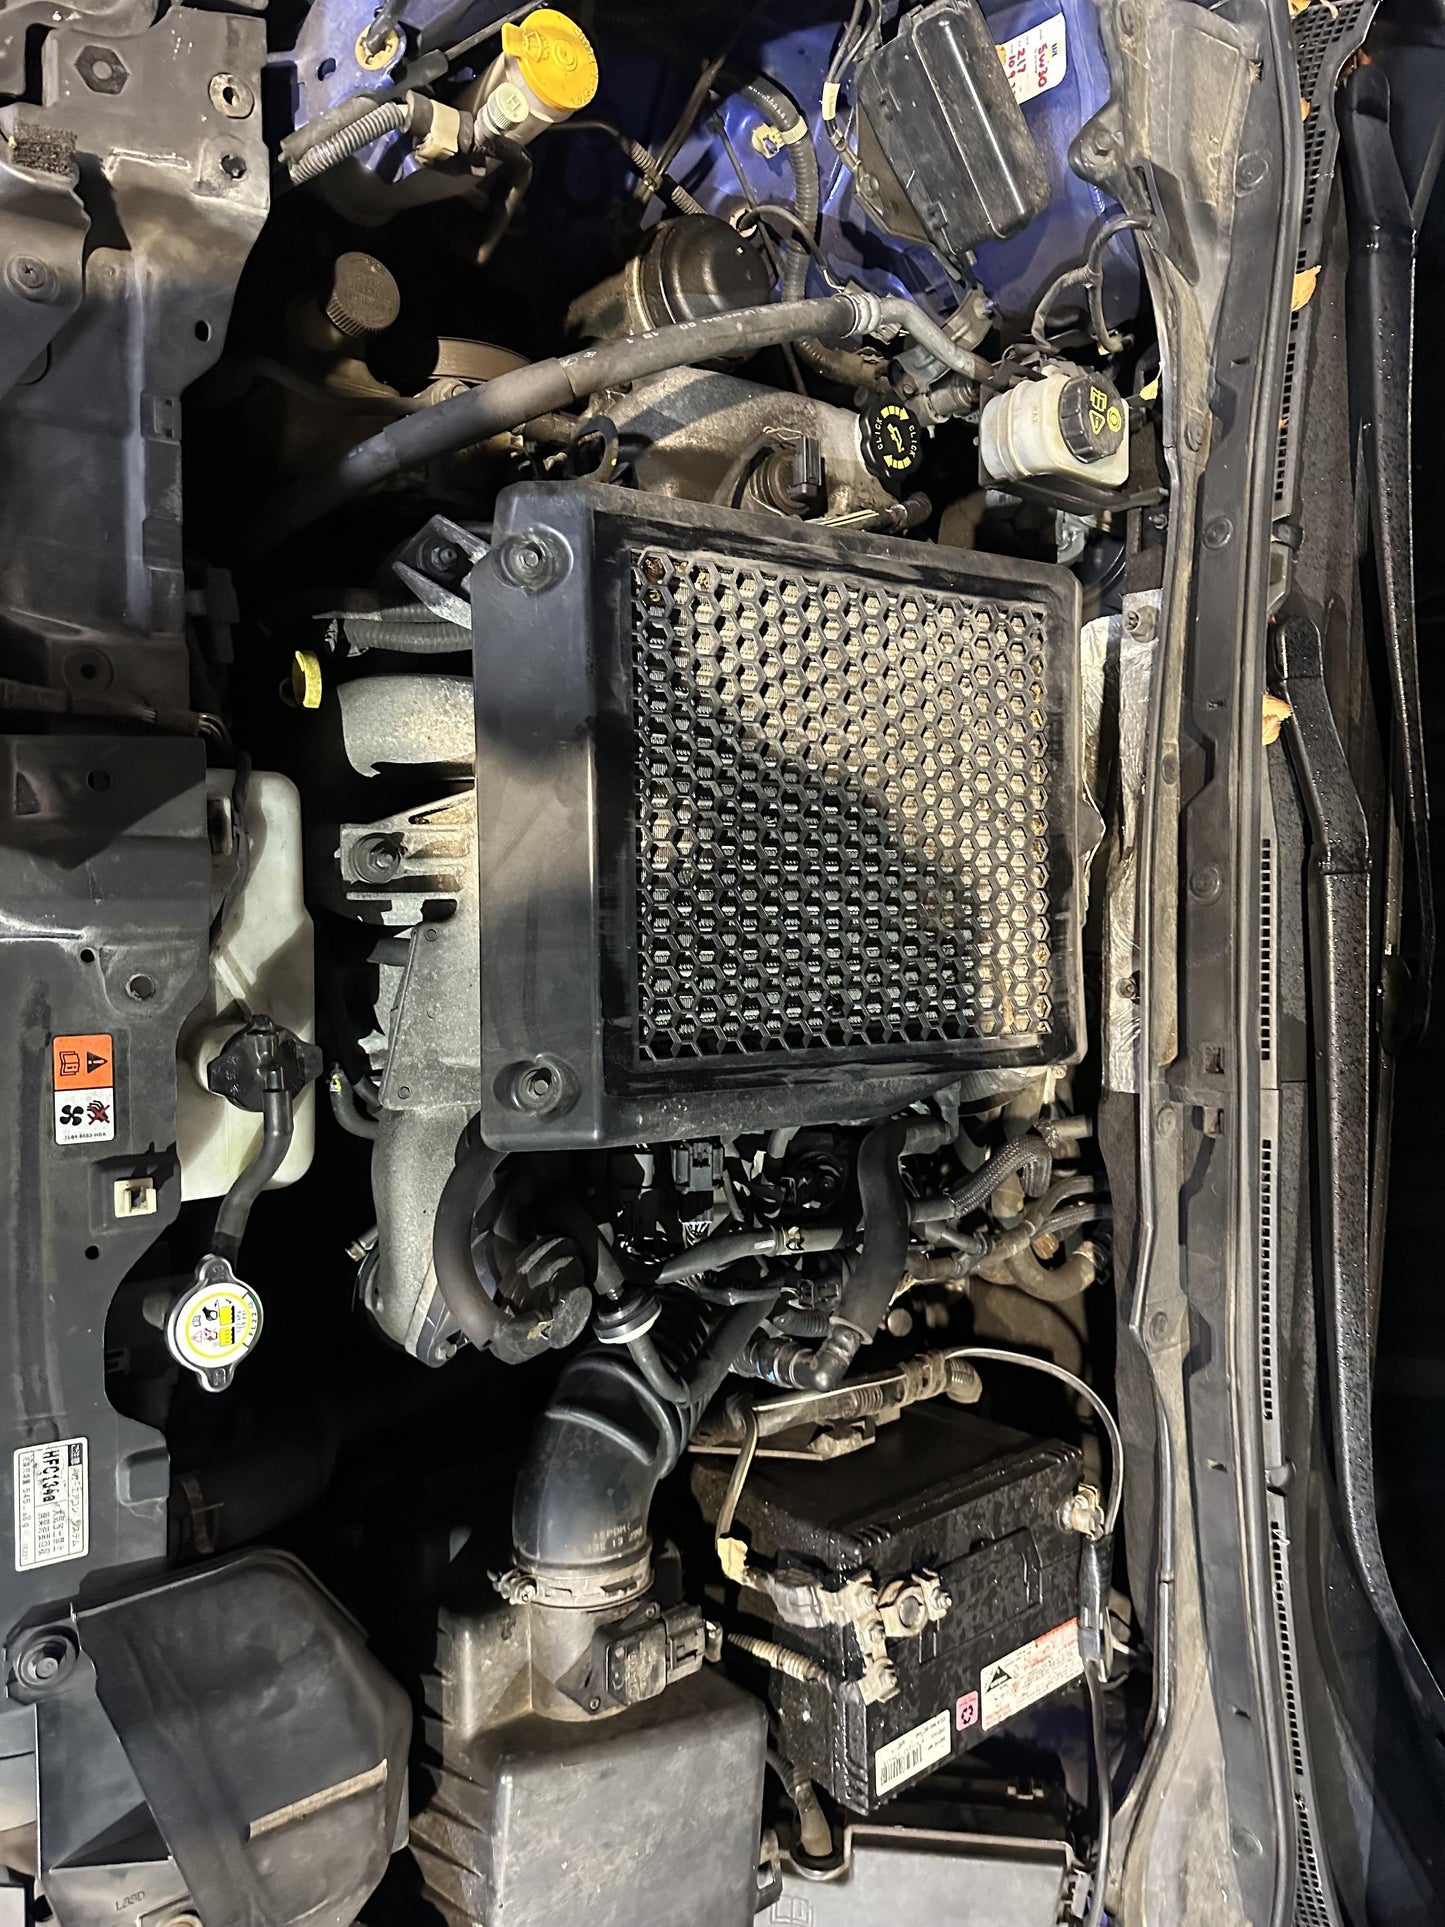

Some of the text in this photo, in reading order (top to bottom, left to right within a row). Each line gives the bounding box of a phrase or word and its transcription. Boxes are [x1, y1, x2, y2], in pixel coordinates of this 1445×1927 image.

[875, 417, 883, 450] CLICK
[909, 425, 917, 457] CLICK
[249, 1312, 257, 1336] FL22
[42, 1449, 60, 1503] HFC134a
